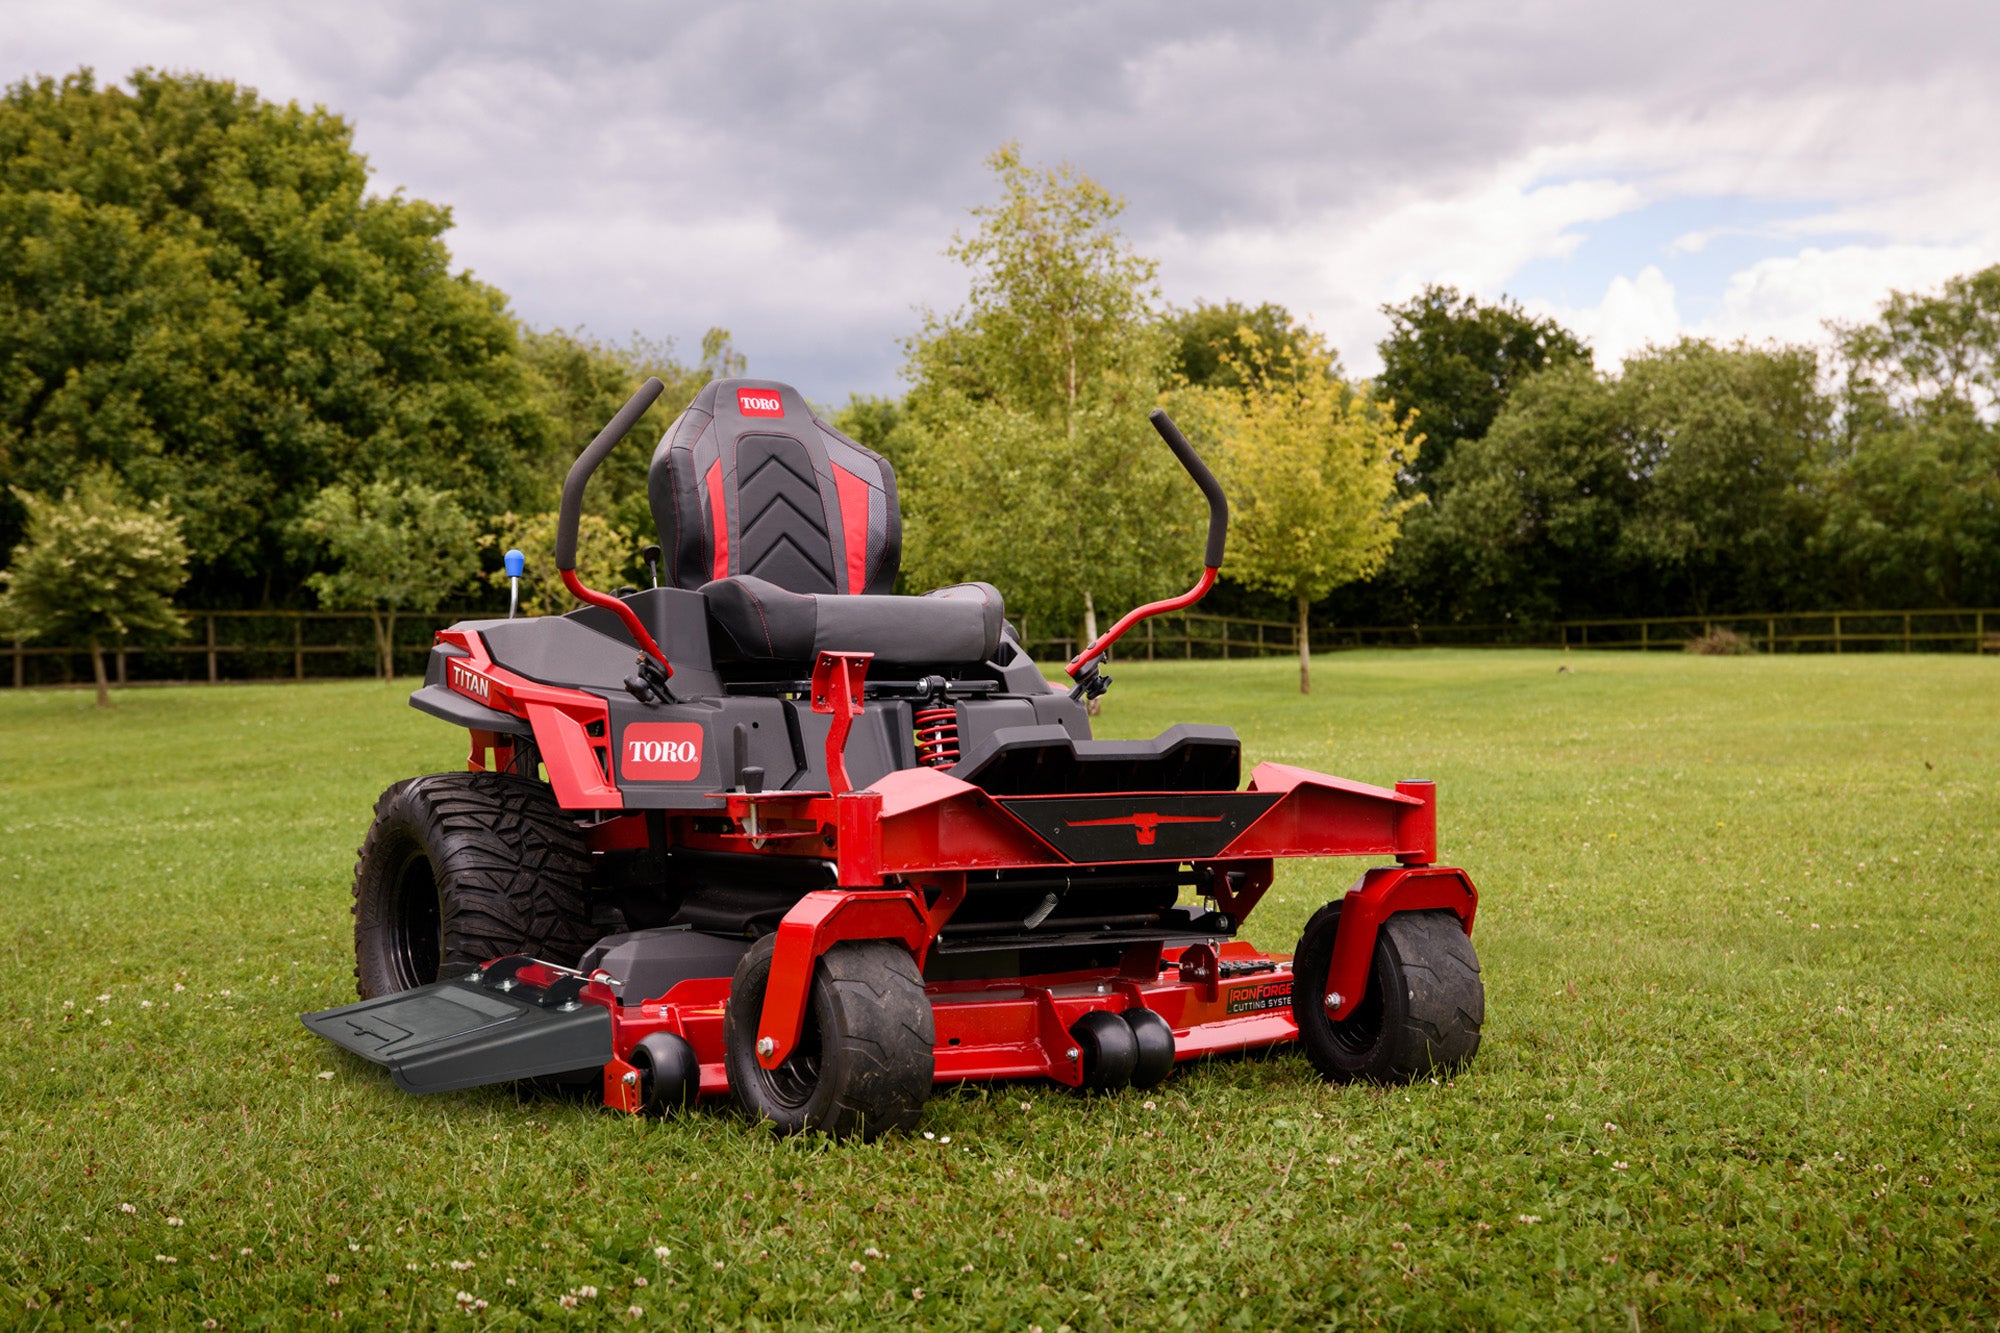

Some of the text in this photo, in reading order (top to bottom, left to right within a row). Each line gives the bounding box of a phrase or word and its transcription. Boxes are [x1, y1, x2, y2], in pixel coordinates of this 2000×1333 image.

[740, 397, 779, 410] TORO
[453, 665, 489, 698] TITAN
[1232, 996, 1292, 1013] CUTTING SYSTE
